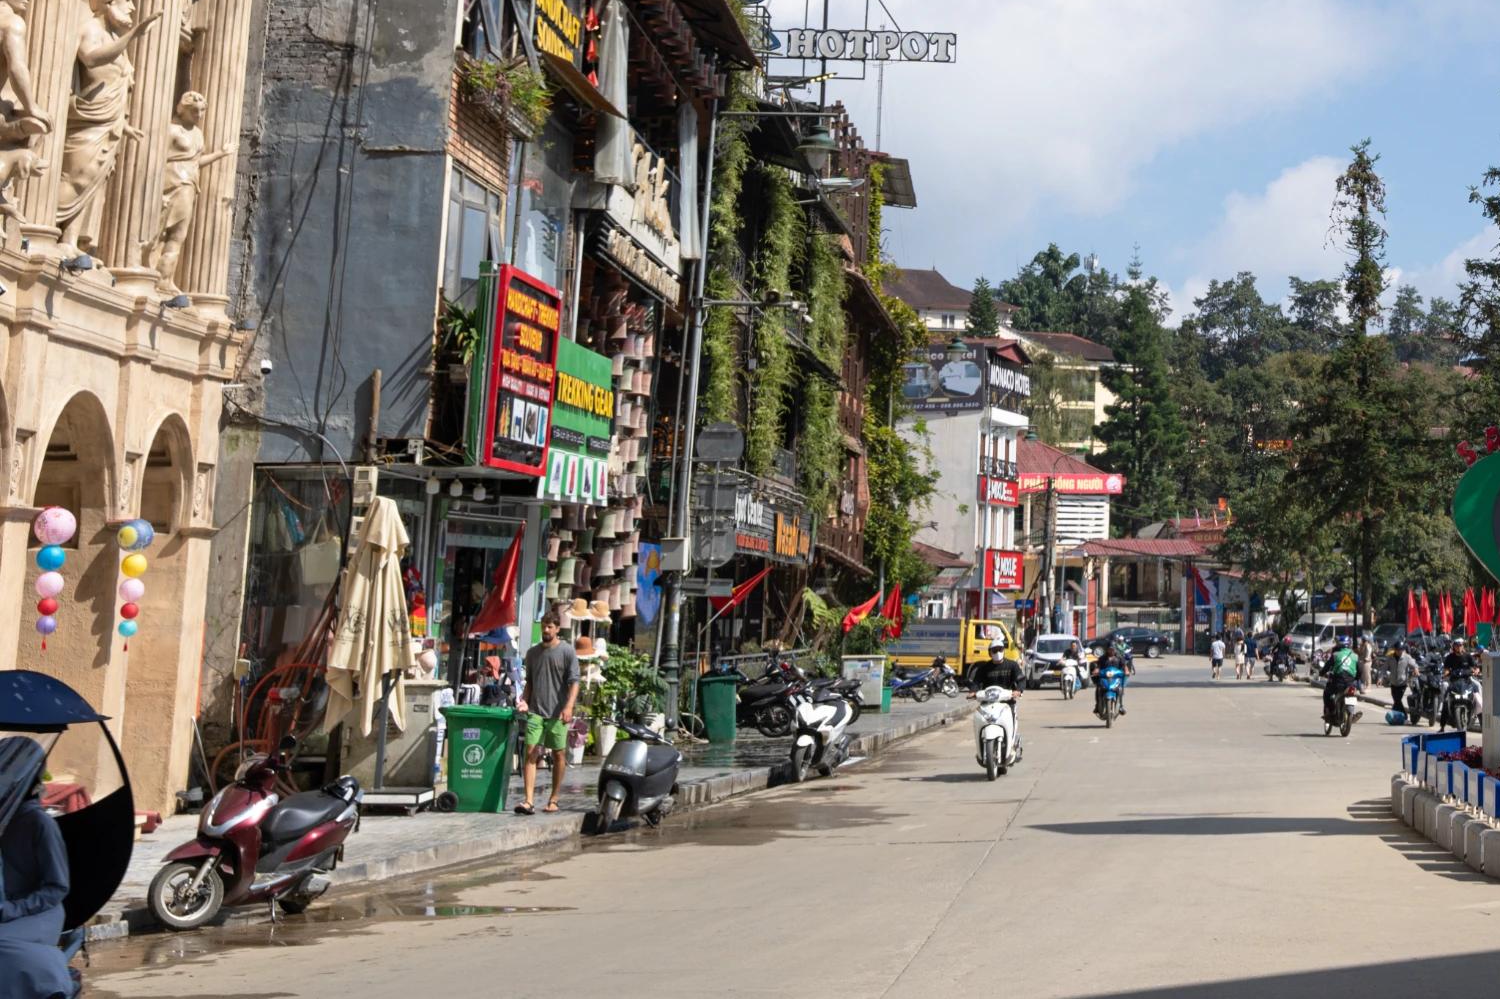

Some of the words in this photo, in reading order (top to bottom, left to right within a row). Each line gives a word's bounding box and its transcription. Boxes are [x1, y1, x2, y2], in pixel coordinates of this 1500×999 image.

[787, 28, 957, 62] HOTPOT
[557, 372, 594, 412] TREKKING
[594, 386, 614, 418] GEAR
[990, 364, 1014, 391] MONACO
[1014, 373, 1031, 396] HOTEL
[1077, 477, 1103, 490] NGƯỜI
